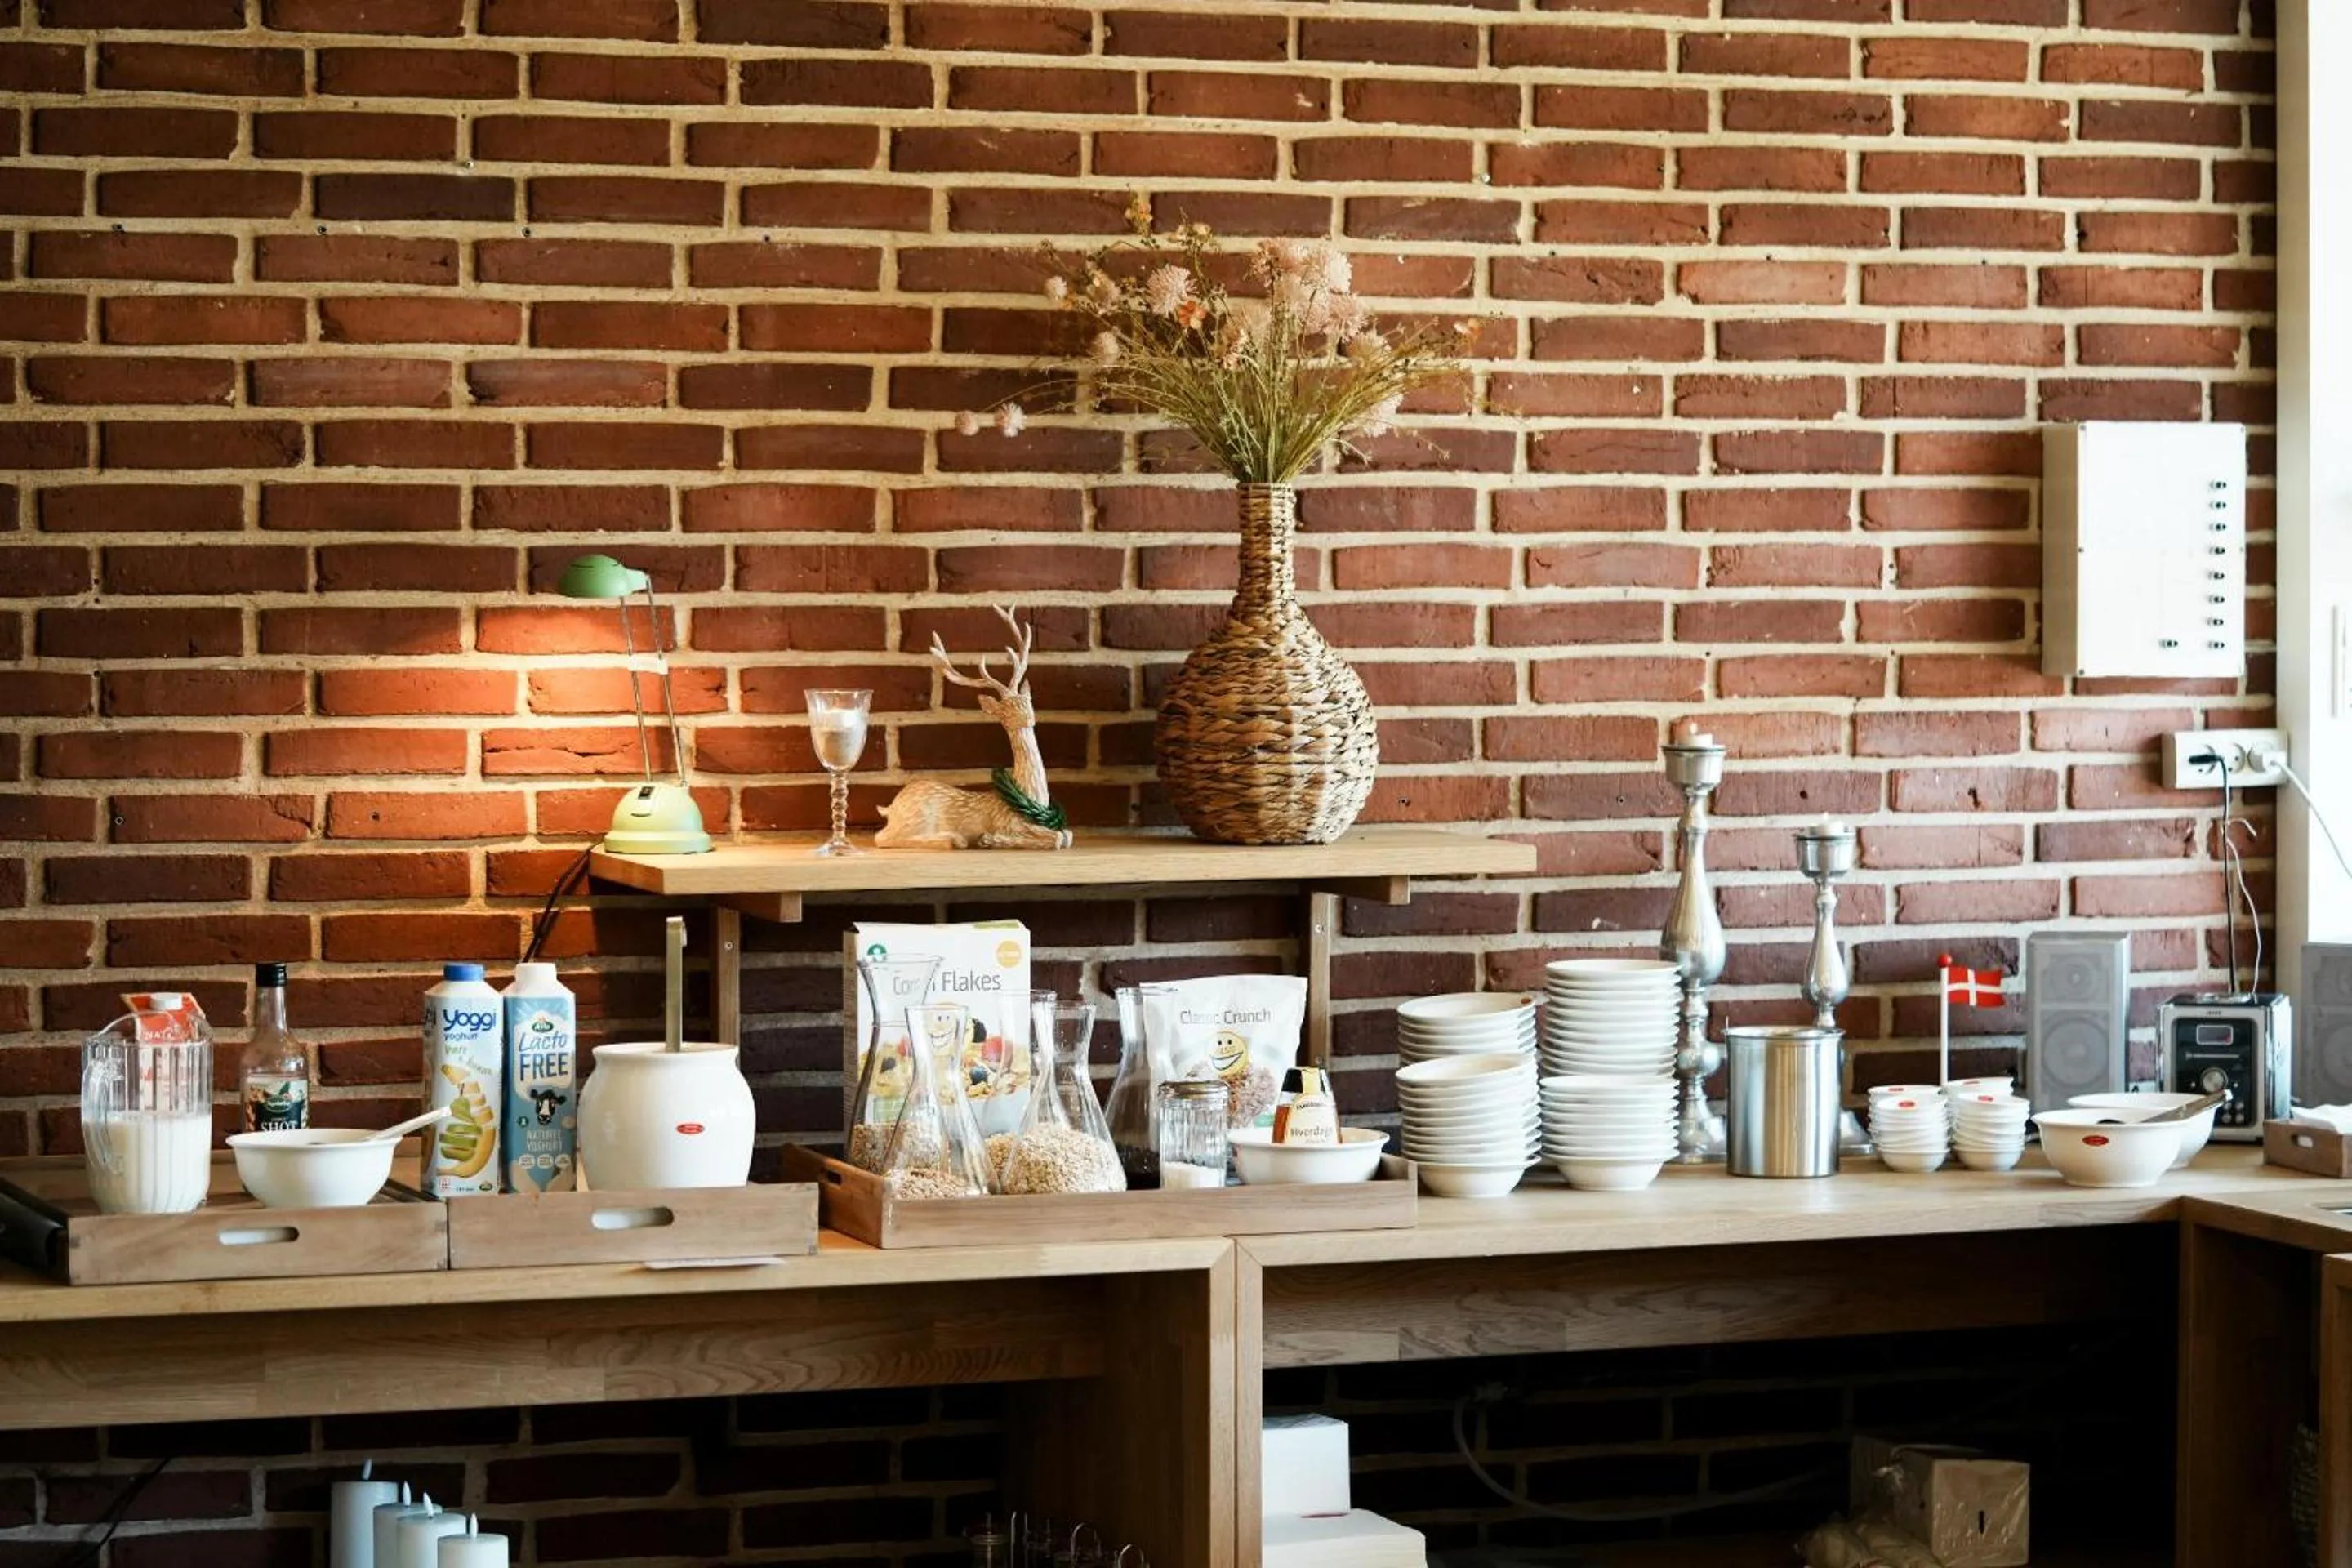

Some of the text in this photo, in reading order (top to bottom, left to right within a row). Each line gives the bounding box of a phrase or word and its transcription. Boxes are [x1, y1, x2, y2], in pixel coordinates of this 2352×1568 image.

[942, 969, 1001, 992] Flakes
[1180, 1007, 1272, 1025] Claic Crunch
[519, 1031, 568, 1052] Lacto
[519, 1052, 569, 1082] FREE
[261, 1120, 298, 1132] SHOT
